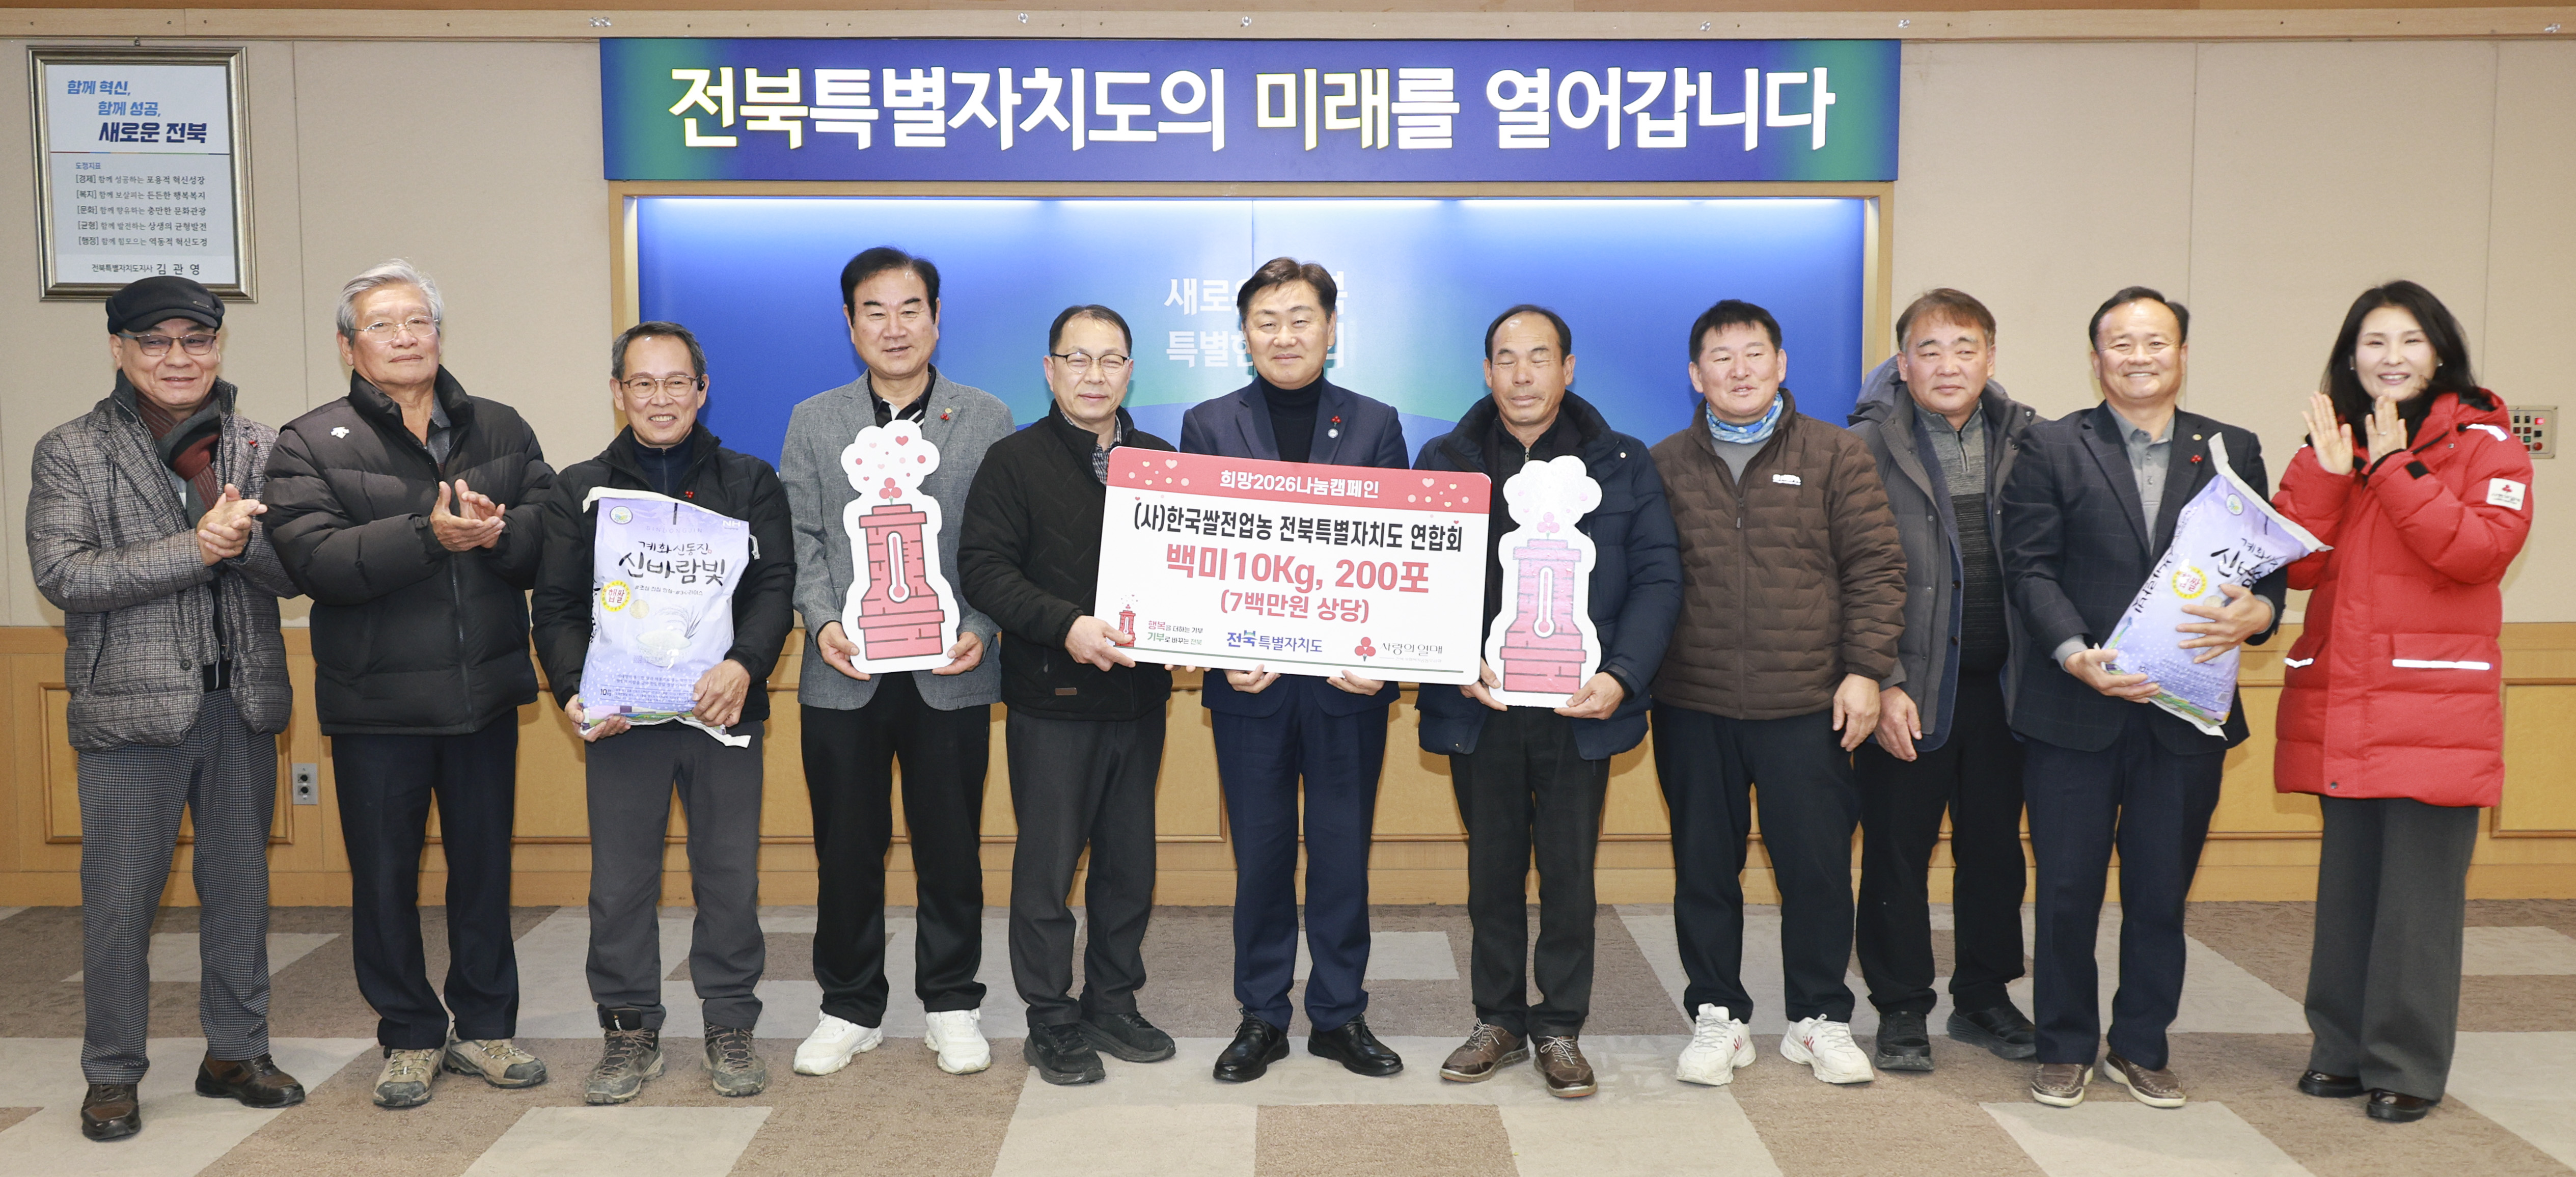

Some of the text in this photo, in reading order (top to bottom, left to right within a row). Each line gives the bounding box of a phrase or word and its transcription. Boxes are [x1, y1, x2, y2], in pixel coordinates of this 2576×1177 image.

[68, 80, 130, 96] 함께 혁신,
[98, 101, 160, 117] 함께 성공,
[669, 67, 1836, 152] 전북특별자치도의 미래를 열어갑니다
[99, 122, 207, 143] 새로운 전북
[76, 175, 96, 183] [경제]
[115, 176, 144, 184] 성공하는
[147, 176, 170, 184] 포용적
[173, 176, 205, 185] 혁신성장
[76, 190, 97, 199] [복지]
[77, 205, 97, 214] [문화]
[100, 206, 114, 214] 함께
[174, 207, 206, 216] 문화관광
[78, 221, 98, 230] [균형]
[117, 222, 146, 230] 발전하는
[148, 222, 172, 231] 상생의
[78, 236, 99, 245] [행정]
[149, 237, 173, 246] 역동적
[92, 264, 153, 272] 전북특별자치도지사
[1164, 278, 1241, 316] 새로
[1220, 470, 1379, 499] 희망2026나눔캠페인
[646, 526, 703, 534] SINDONGJIN
[1134, 501, 1463, 552] (사)한국쌀전업농 전북특별자치도 연합회
[618, 552, 726, 586] 신바람빛
[1167, 543, 1429, 593] 백미10Kg, 200포
[609, 589, 624, 604] 햅쌀
[1221, 589, 1369, 624] (7백만원 상당)
[1148, 620, 1171, 632] 행복을
[1147, 632, 1170, 643] 기부로
[1172, 637, 1189, 645] 바꾸는
[1226, 630, 1323, 652] 전북특별자치도
[1380, 643, 1442, 656] 사랑의 열매
